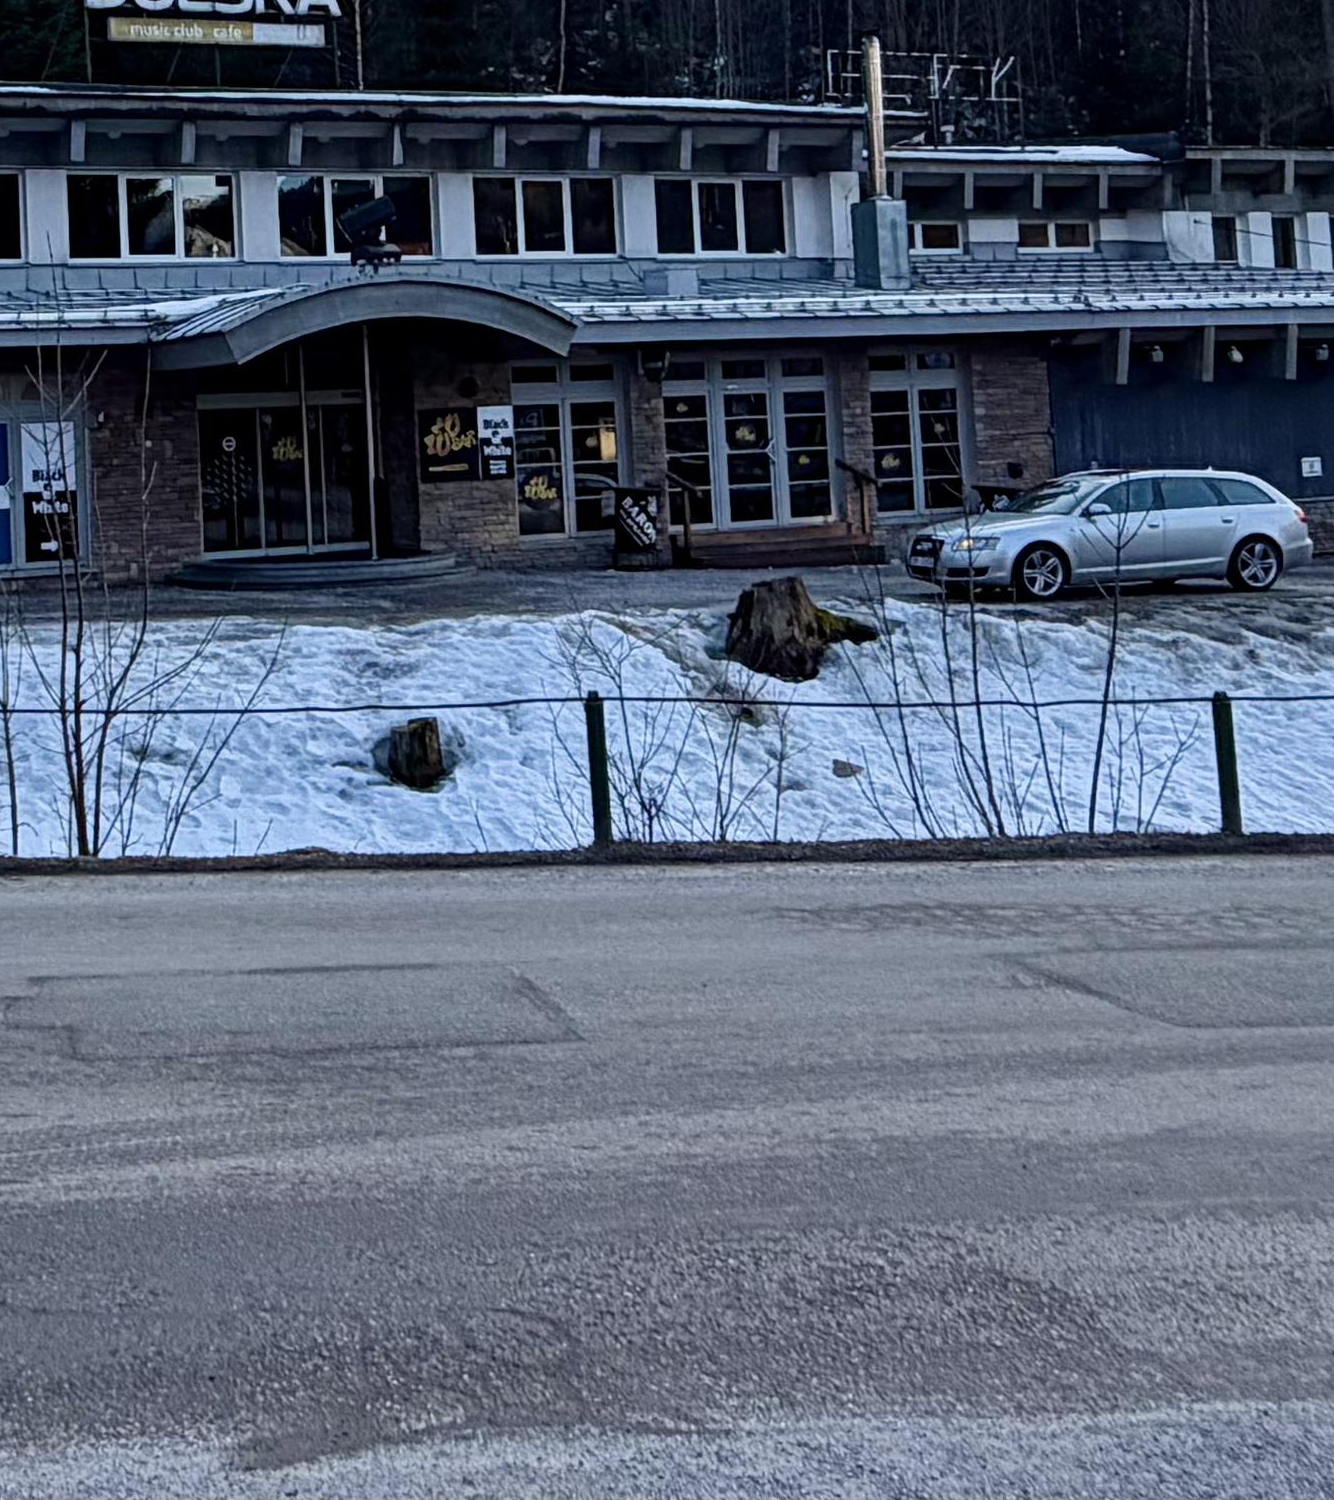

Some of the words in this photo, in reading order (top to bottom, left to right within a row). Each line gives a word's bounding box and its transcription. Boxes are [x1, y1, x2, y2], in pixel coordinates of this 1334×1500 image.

[129, 21, 170, 37] music
[173, 22, 203, 38] club
[213, 25, 243, 39] cafe
[621, 495, 657, 544] BARON
